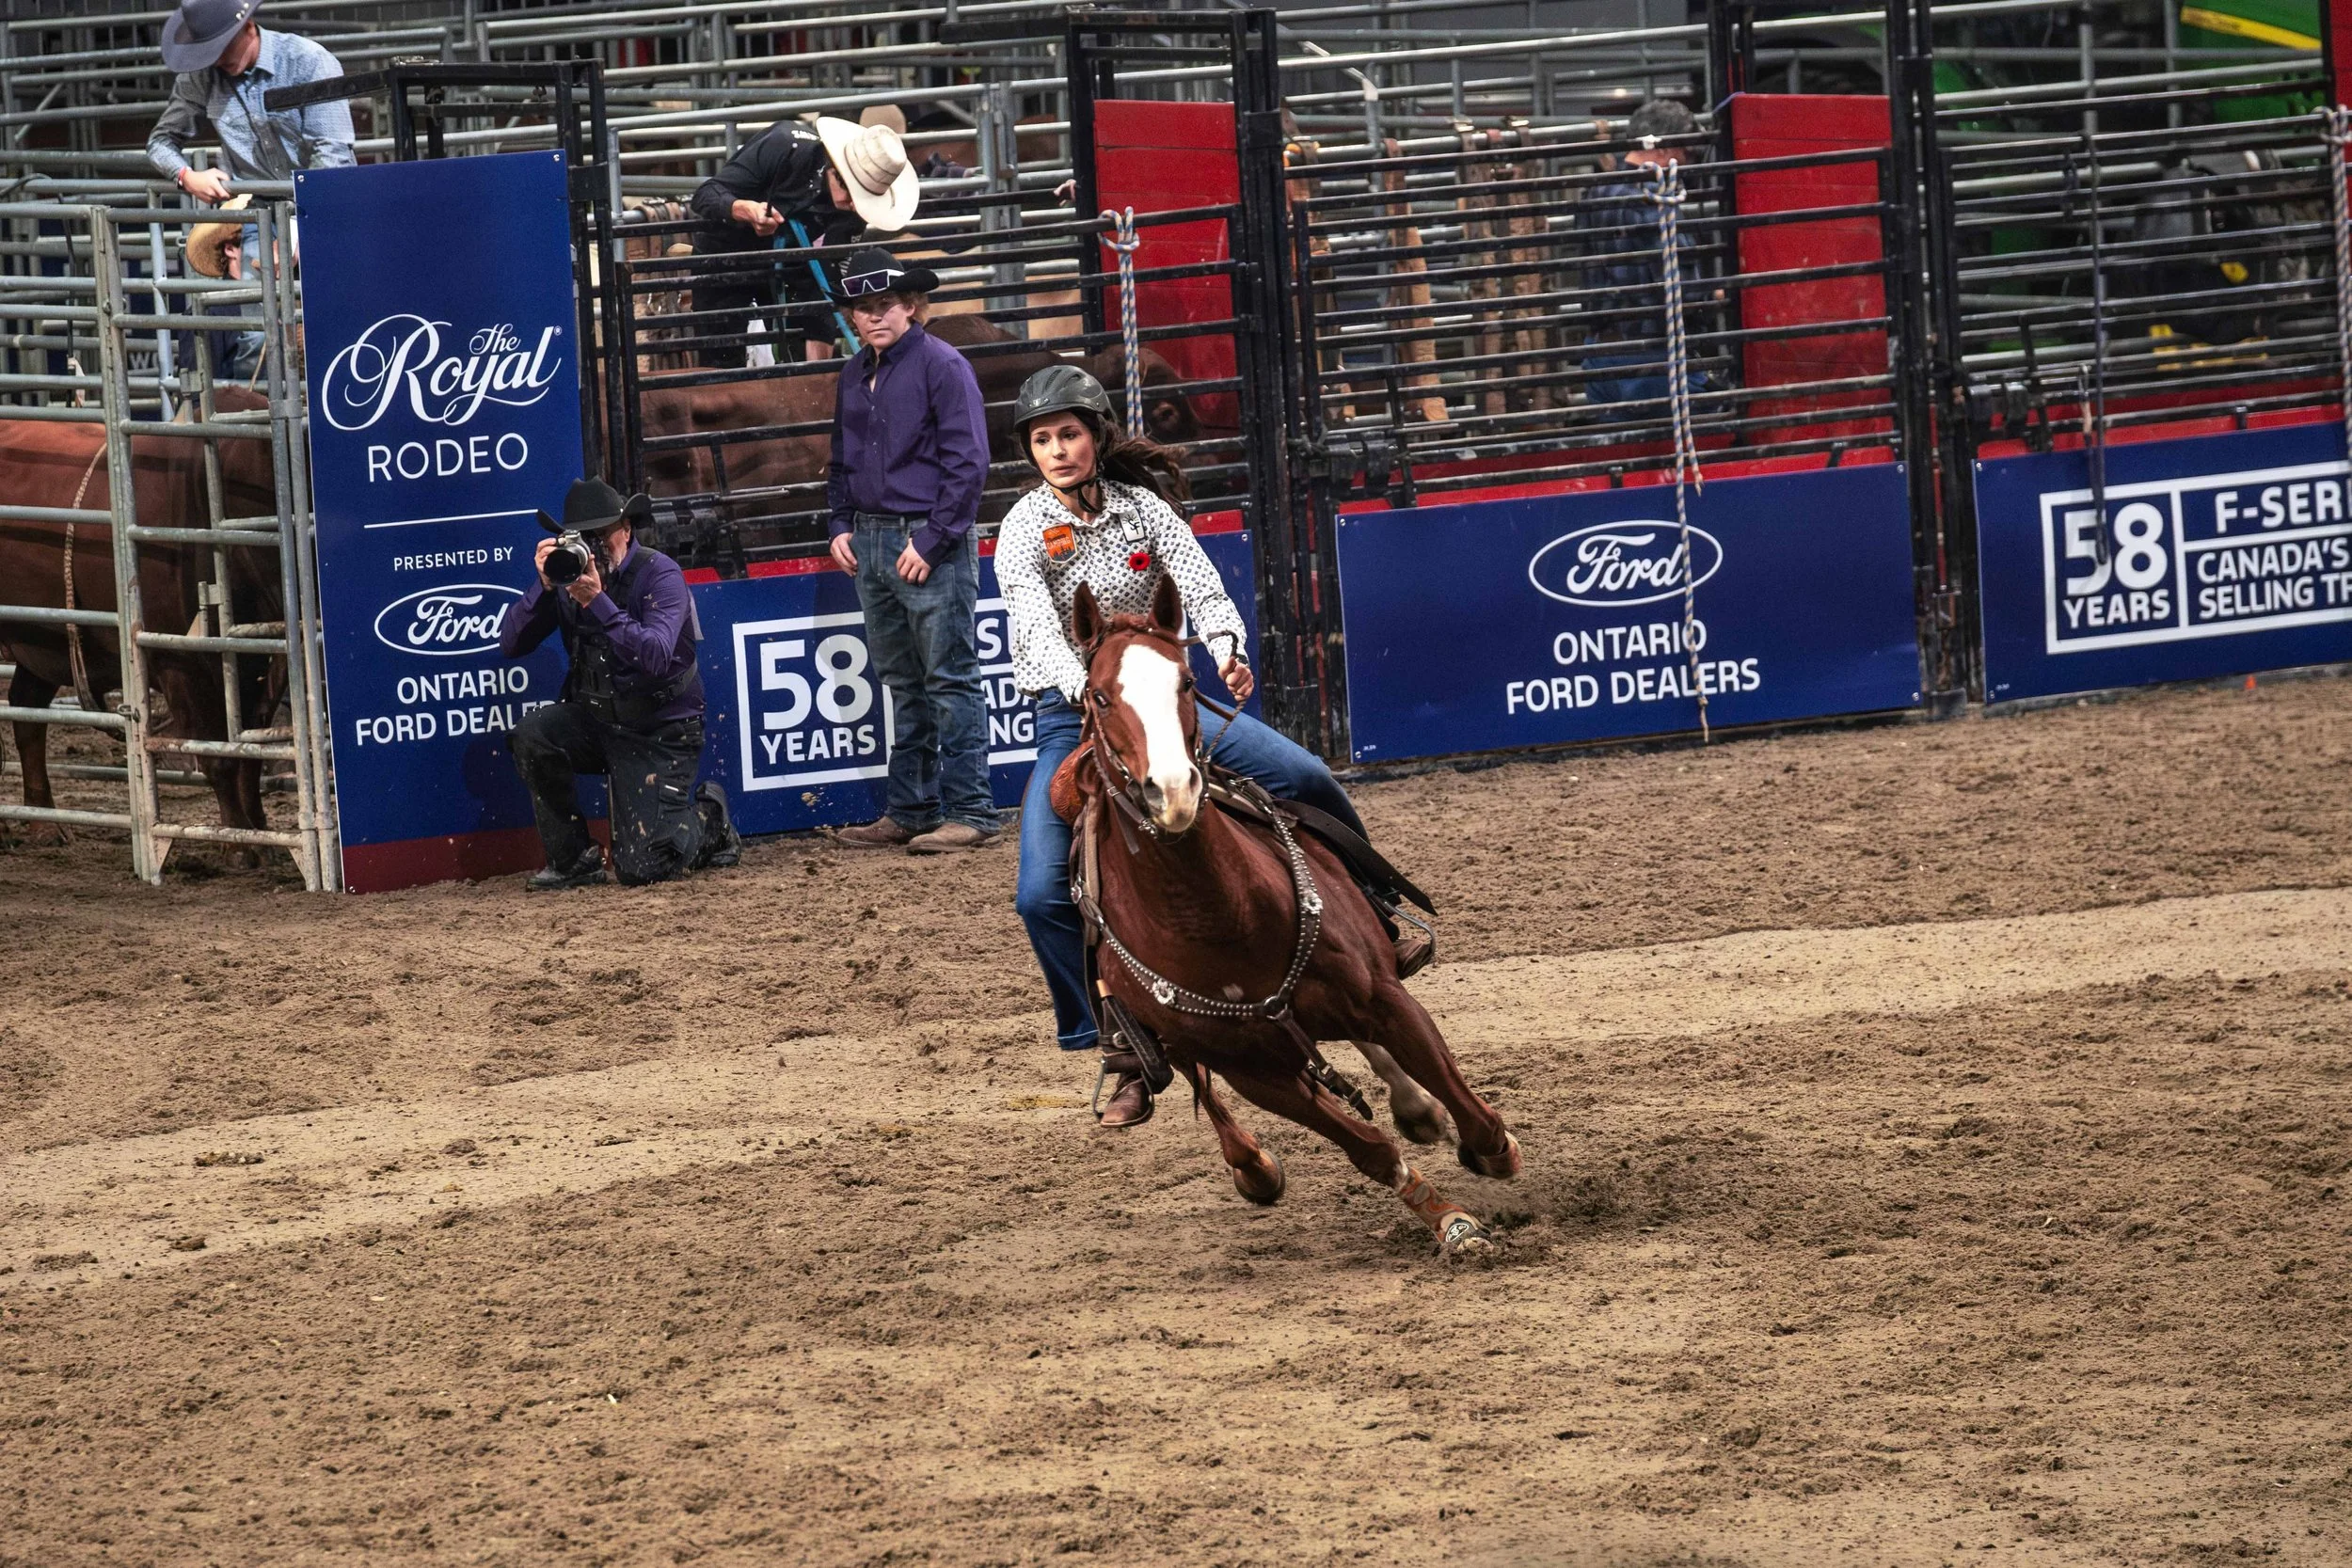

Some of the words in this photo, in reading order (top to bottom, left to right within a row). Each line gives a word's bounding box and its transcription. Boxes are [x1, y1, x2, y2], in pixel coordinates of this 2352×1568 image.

[469, 323, 521, 355] The
[322, 313, 562, 431] Royal
[367, 433, 528, 483] RODEO
[393, 549, 487, 571] PRESENTED
[494, 546, 514, 561] BY
[1566, 533, 1684, 594] Ford
[2064, 502, 2168, 596] 58
[2198, 537, 2350, 583] CANADA'S
[407, 594, 509, 645] Ford
[2062, 588, 2170, 629] YEARS
[2199, 575, 2315, 620] SELLING
[1553, 619, 1708, 665] ONTARIO
[397, 666, 529, 704] ONTARIO
[759, 634, 873, 730] 58
[1506, 674, 1599, 715] FORD
[1611, 657, 1761, 704] DEALERS
[356, 712, 437, 746] FORD
[759, 724, 876, 765] YEARS
